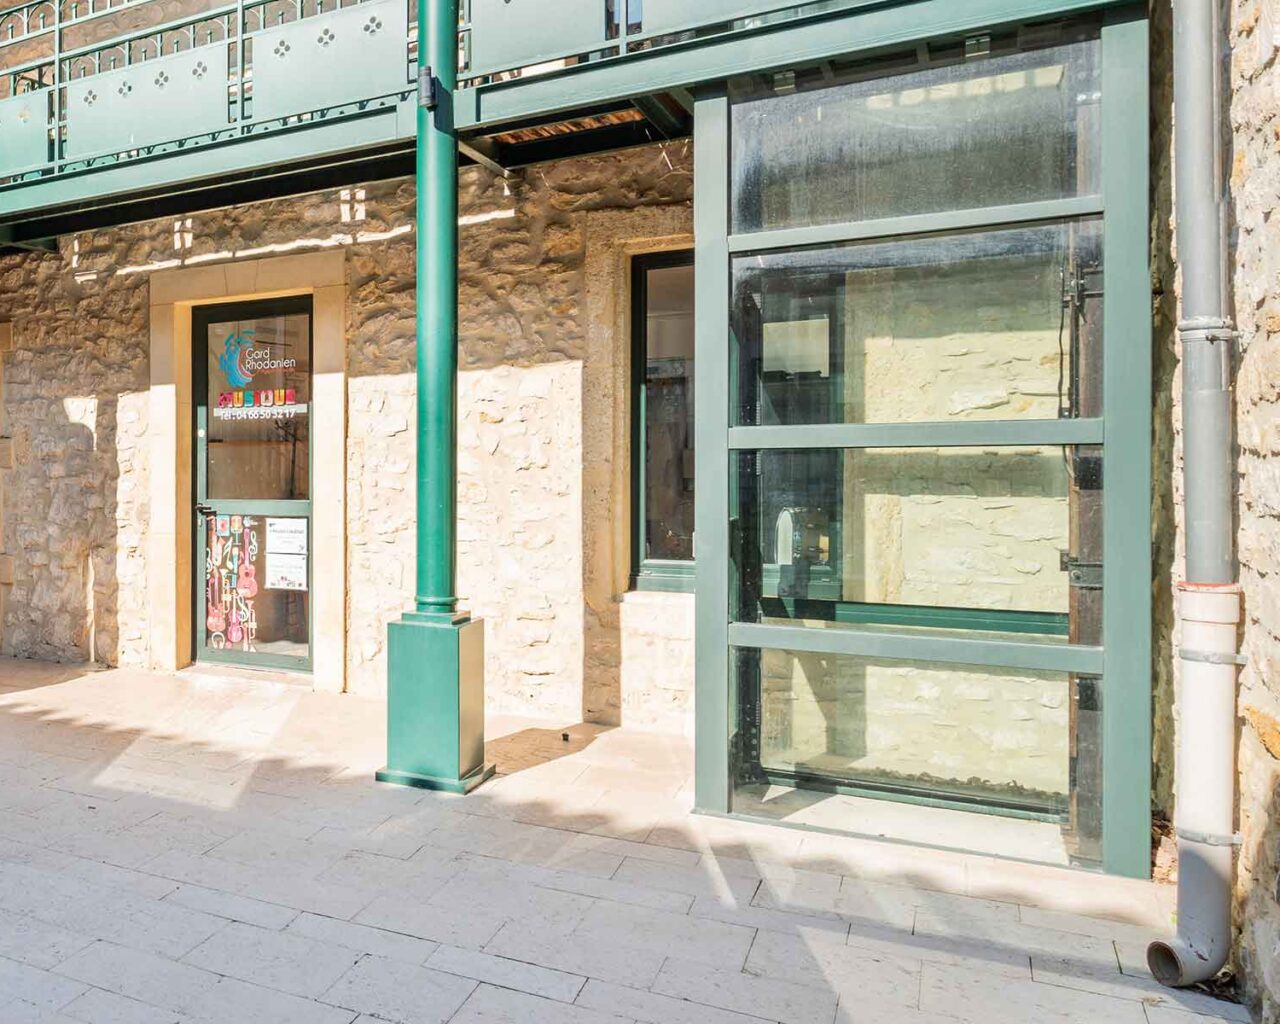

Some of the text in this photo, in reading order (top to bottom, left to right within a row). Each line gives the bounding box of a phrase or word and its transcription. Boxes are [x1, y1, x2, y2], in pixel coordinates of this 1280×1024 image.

[246, 347, 270, 359] Gard
[245, 358, 296, 370] Rhodanien
[218, 388, 296, 408] MUSIQUE
[248, 409, 260, 420] 66
[260, 409, 271, 419] 50
